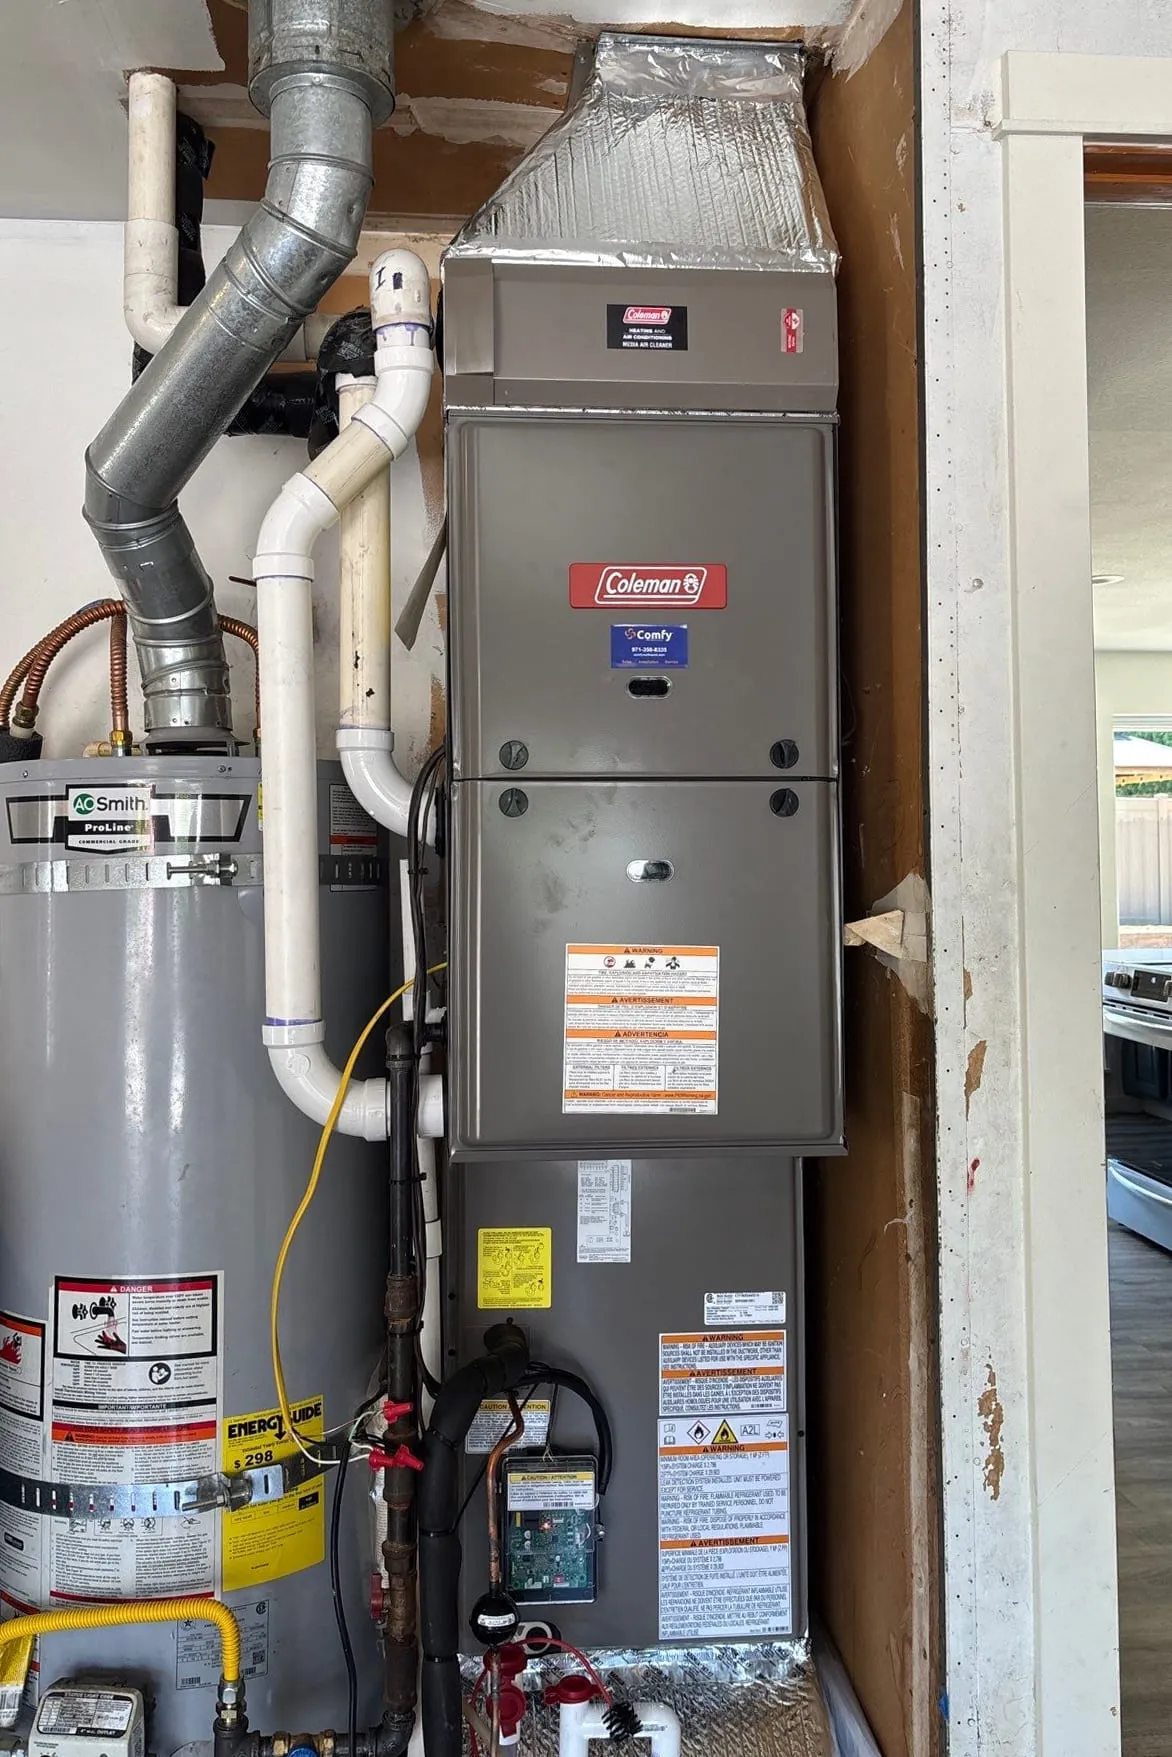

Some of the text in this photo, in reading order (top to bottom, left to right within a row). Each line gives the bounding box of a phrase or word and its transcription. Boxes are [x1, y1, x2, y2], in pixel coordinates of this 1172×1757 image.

[627, 309, 660, 320] Coleman
[605, 571, 682, 595] Coleman
[637, 629, 673, 642] Comfy
[97, 796, 146, 811] Smith
[84, 823, 132, 832] ProLine
[619, 997, 674, 1005] AVERTISSEMENT
[622, 1031, 669, 1039] ADVERTENCIA
[709, 1334, 744, 1342] WARNING
[697, 1368, 757, 1377] AVERTISSEMENT
[742, 1425, 760, 1436] A2L
[710, 1444, 745, 1453] WARNING
[234, 1450, 274, 1469] $ 298
[698, 1537, 760, 1547] AVERTISSEMENT
